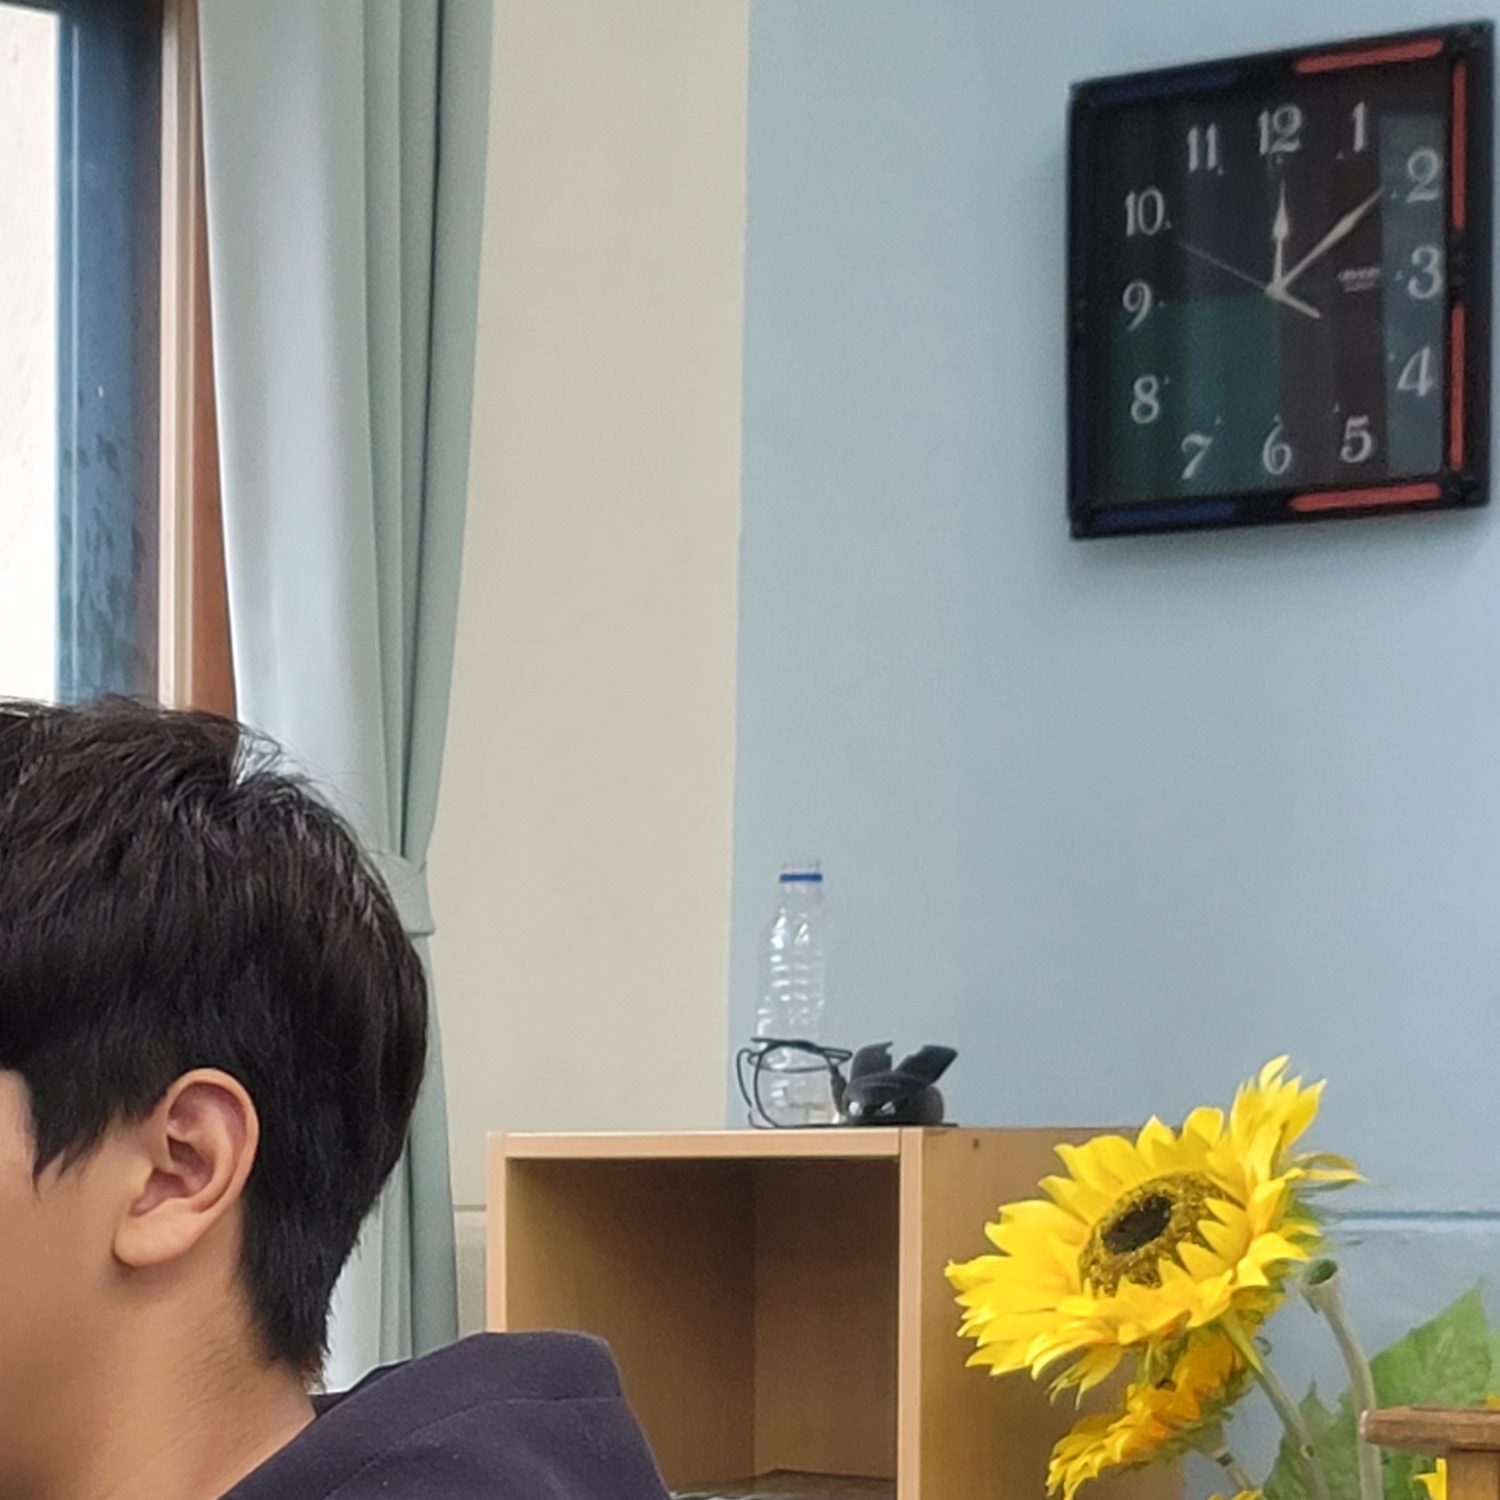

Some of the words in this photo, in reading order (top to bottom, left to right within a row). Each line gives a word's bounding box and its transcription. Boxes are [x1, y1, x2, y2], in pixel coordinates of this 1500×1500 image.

[1186, 123, 1218, 173] 11
[1257, 105, 1301, 155] 12
[1351, 102, 1367, 153] 1
[1406, 147, 1440, 205] 2
[1124, 187, 1165, 236] 10
[1407, 245, 1442, 300] 3
[1122, 280, 1153, 331] 9
[1397, 347, 1435, 397] 4
[1130, 376, 1159, 424] 8
[1181, 434, 1213, 480] 7
[1262, 423, 1292, 475] 6
[1340, 415, 1373, 463] 5
